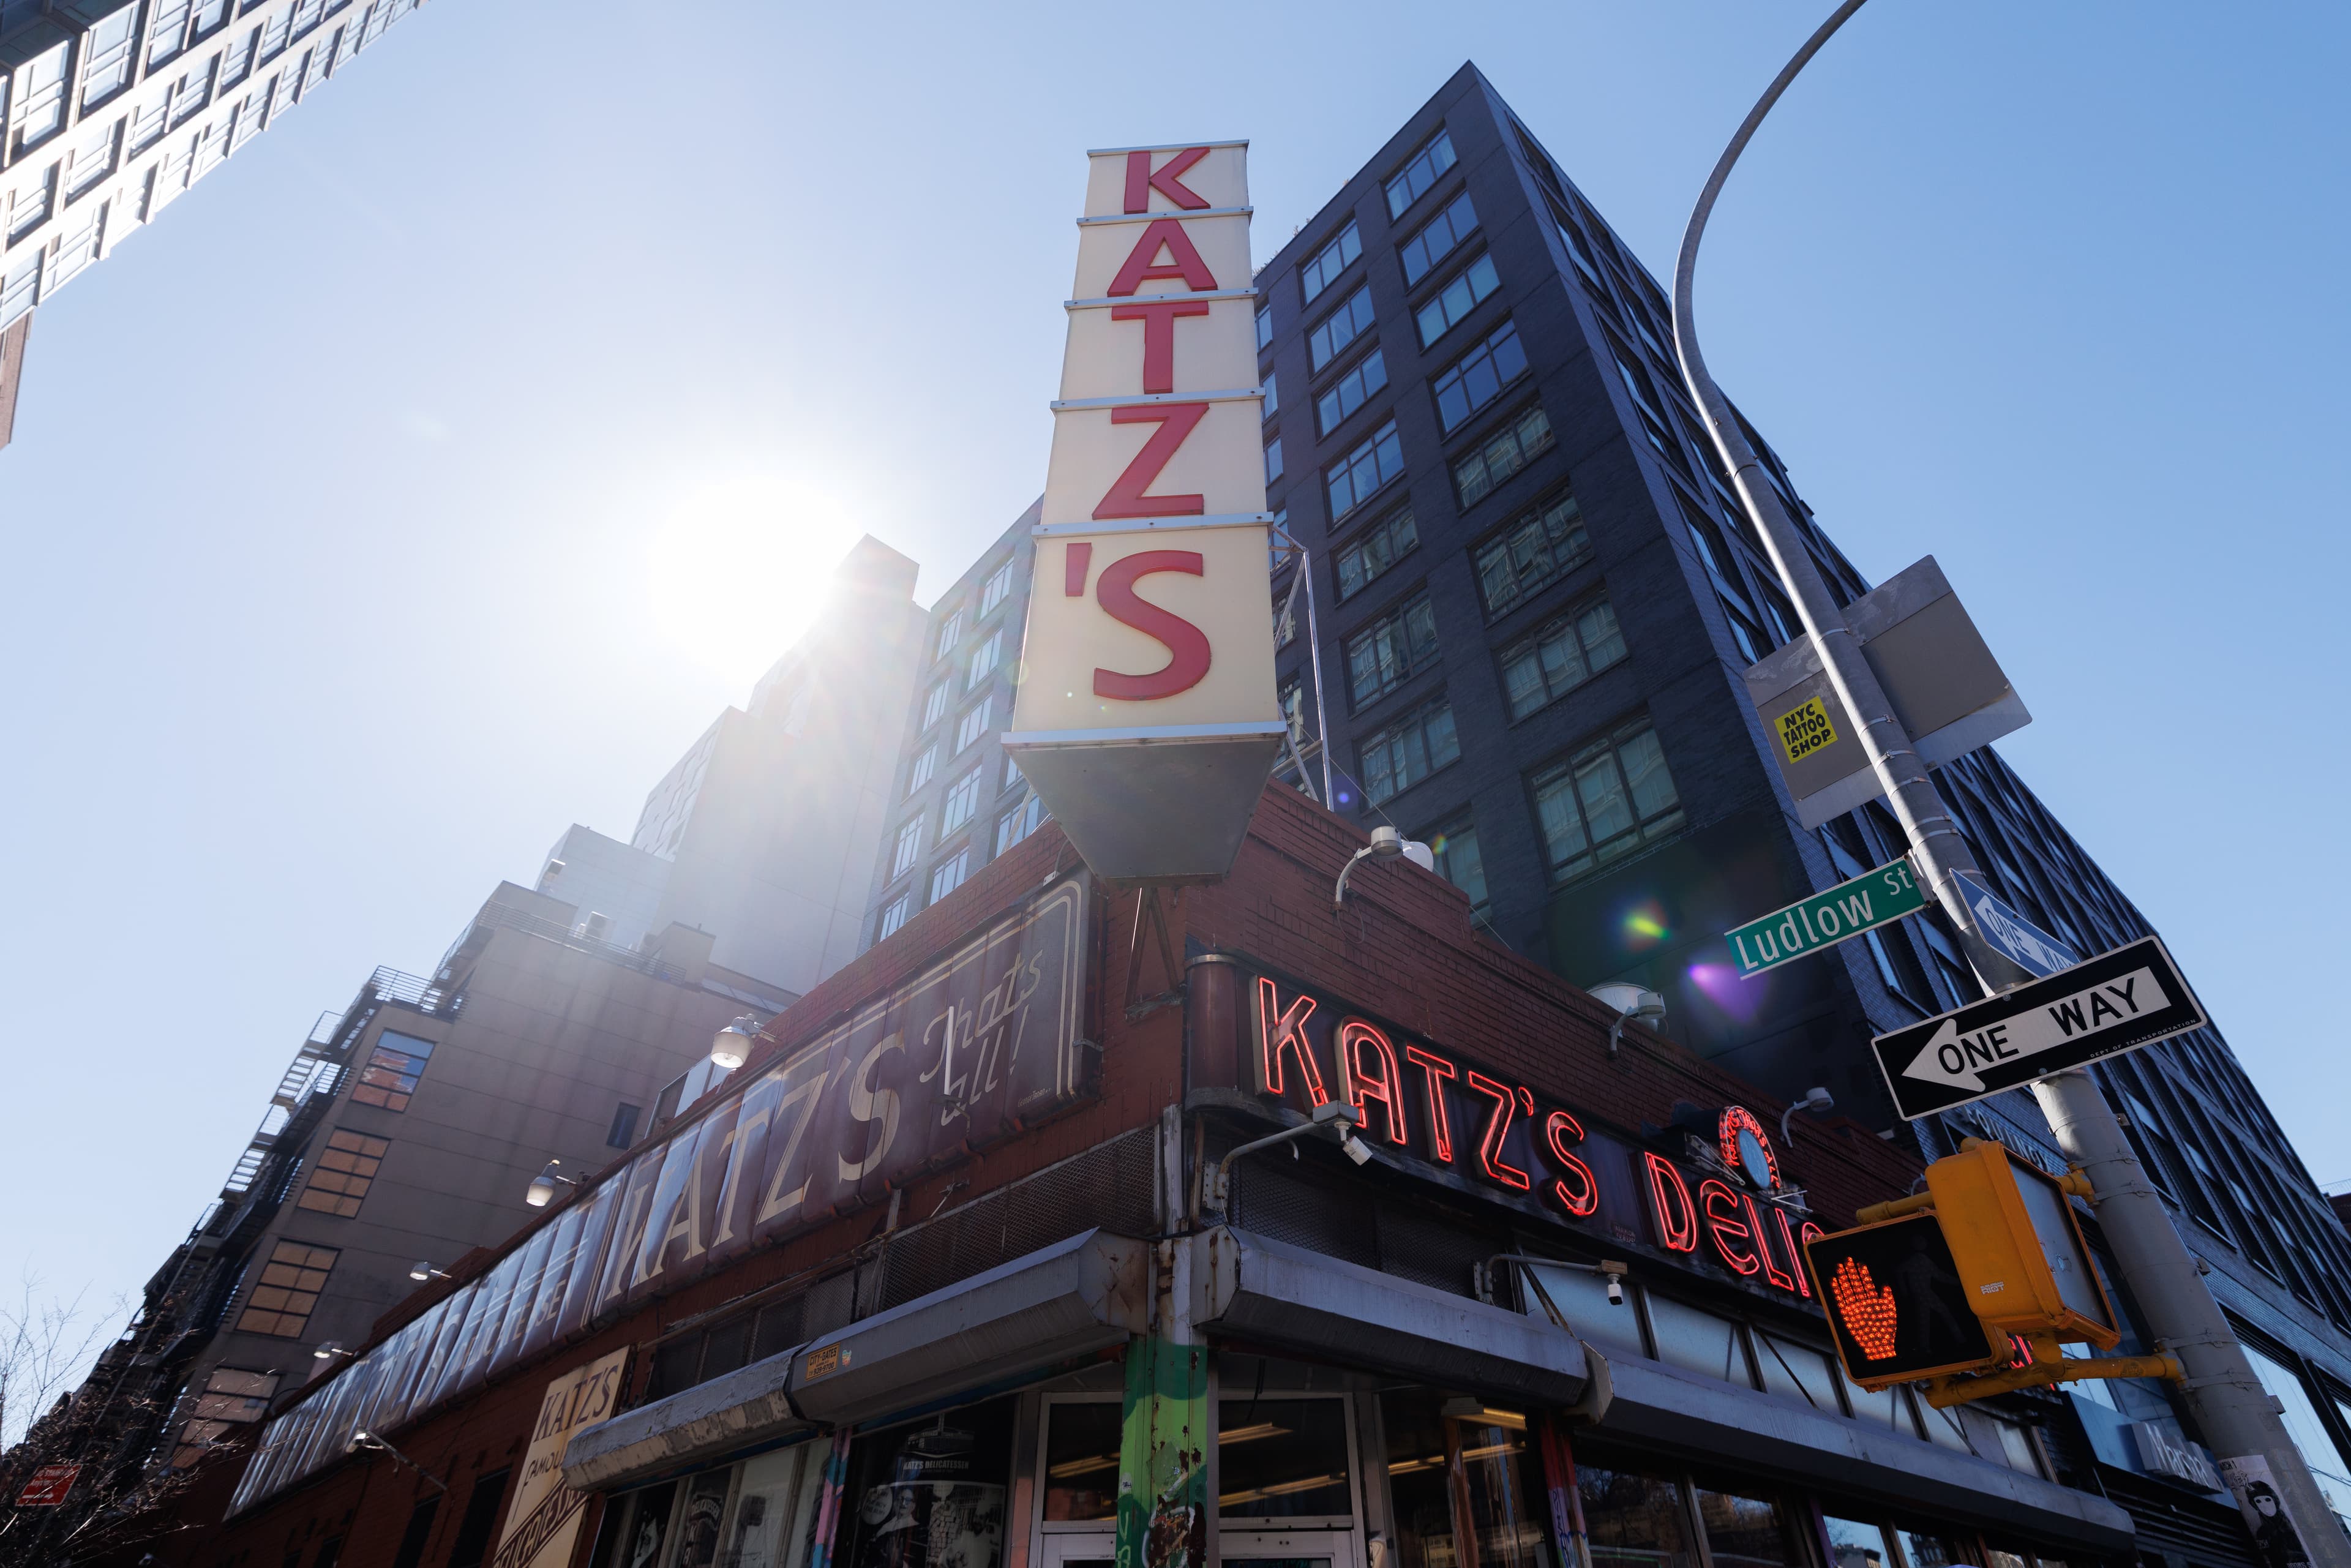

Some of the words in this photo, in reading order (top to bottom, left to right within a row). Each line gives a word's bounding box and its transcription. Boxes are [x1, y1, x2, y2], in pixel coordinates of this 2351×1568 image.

[1064, 146, 1217, 700] KATZ'S
[1783, 714, 1825, 746] TATTOO
[1784, 703, 1815, 729] NYC
[1791, 729, 1831, 758] SHOP
[1734, 889, 1873, 970] Ludlow
[1886, 866, 1913, 897] St
[1985, 907, 2031, 955] ONE
[1938, 1025, 2020, 1075] ONE
[2048, 978, 2142, 1037] WAY
[2090, 1049, 2110, 1058] DEPT
[2126, 1018, 2197, 1046] TRANSPORTATION
[1251, 975, 1599, 1217] KATZ'S
[604, 1029, 906, 1303] KATZ'S
[533, 1363, 619, 1442] KATZ'S
